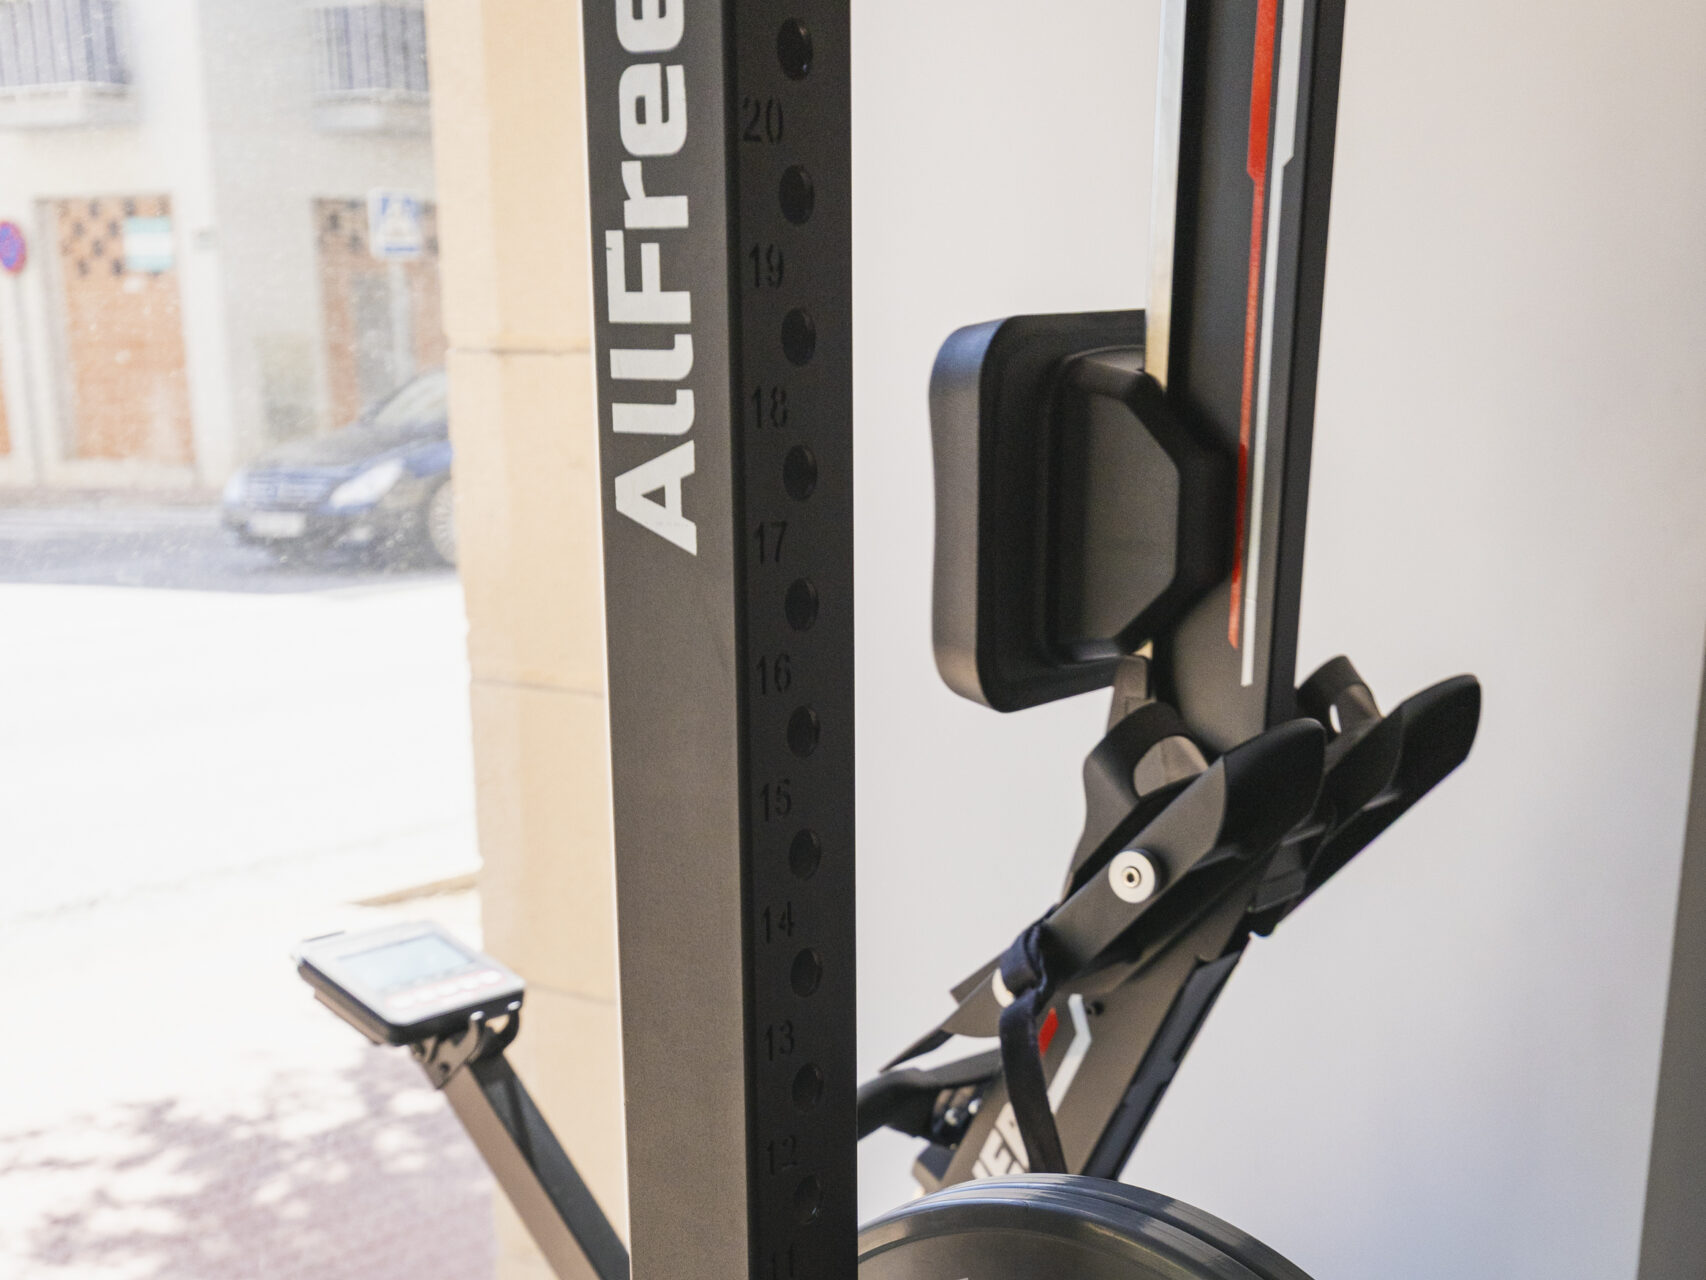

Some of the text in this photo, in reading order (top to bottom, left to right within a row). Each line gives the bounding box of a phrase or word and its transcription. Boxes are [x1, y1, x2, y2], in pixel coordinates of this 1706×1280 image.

[742, 96, 783, 143] 20
[749, 243, 784, 289] 19
[751, 386, 788, 429] 18
[753, 520, 788, 564] 17
[756, 653, 792, 695] 16
[759, 777, 792, 822] 15
[762, 901, 795, 944] 14
[765, 1019, 795, 1061] 13
